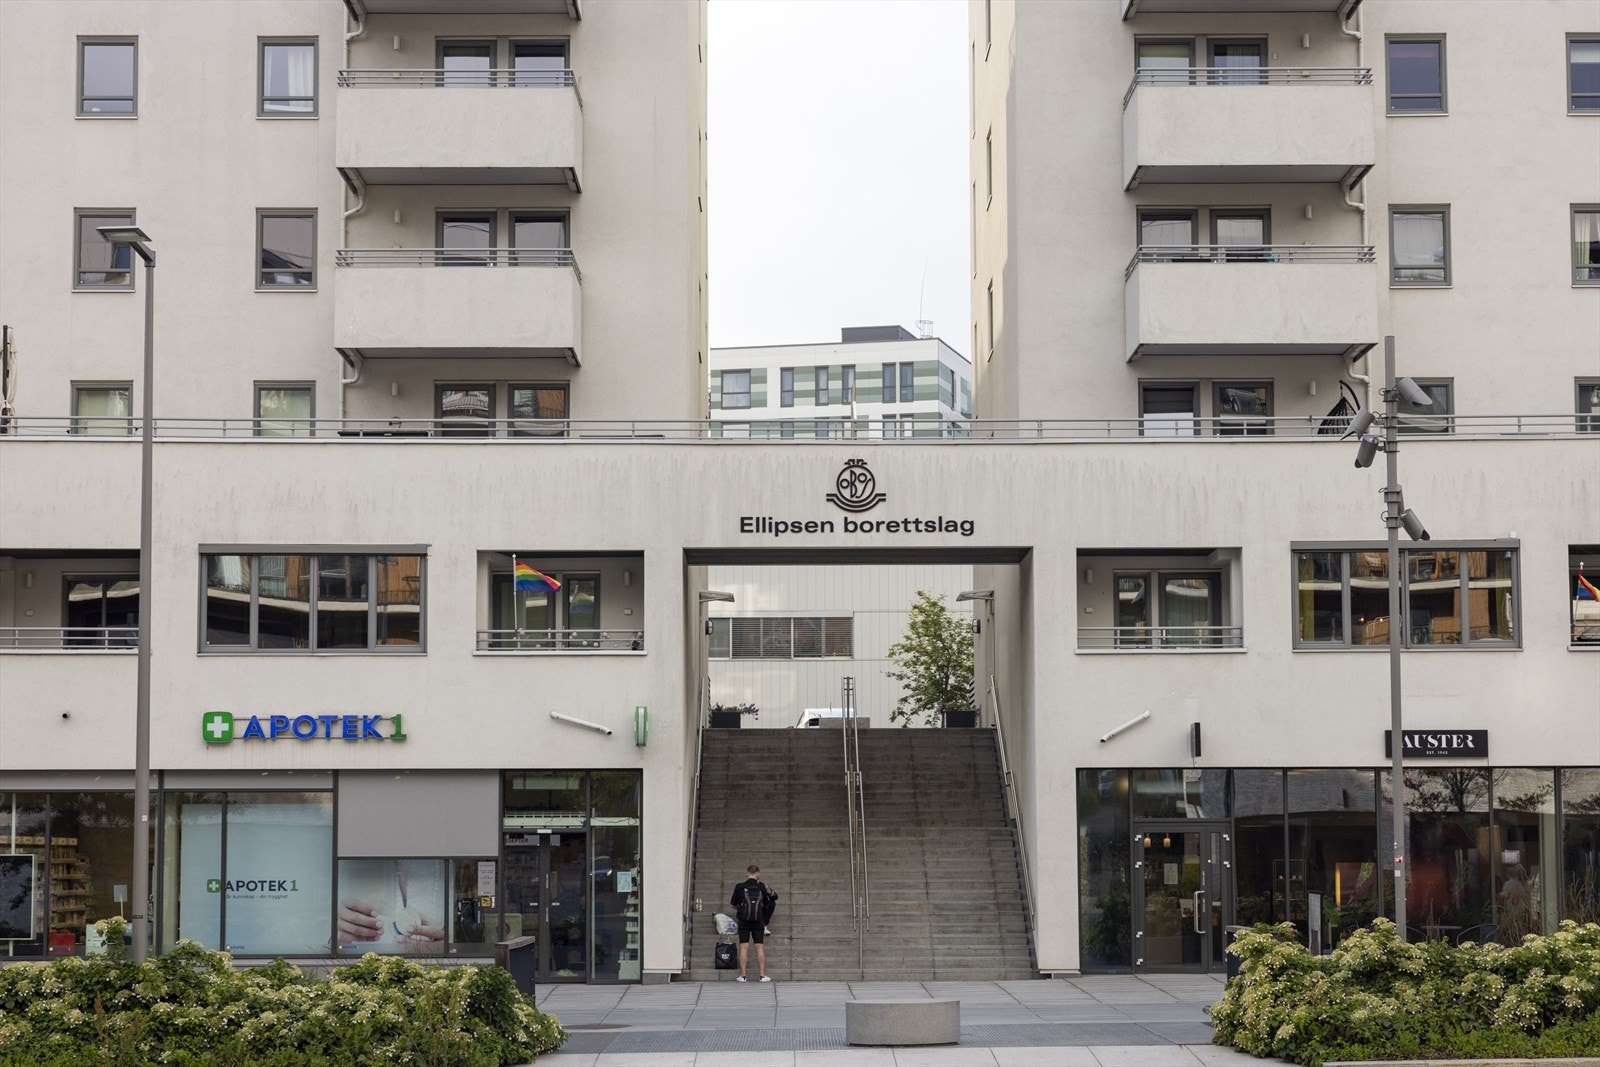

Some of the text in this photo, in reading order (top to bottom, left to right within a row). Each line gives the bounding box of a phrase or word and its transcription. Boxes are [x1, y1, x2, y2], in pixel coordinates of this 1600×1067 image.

[740, 516, 975, 537] Ellipsen borettslag
[242, 713, 407, 741] APOTEK 1
[1402, 734, 1475, 748] AUSTER
[225, 879, 298, 892] APOTEK 1
